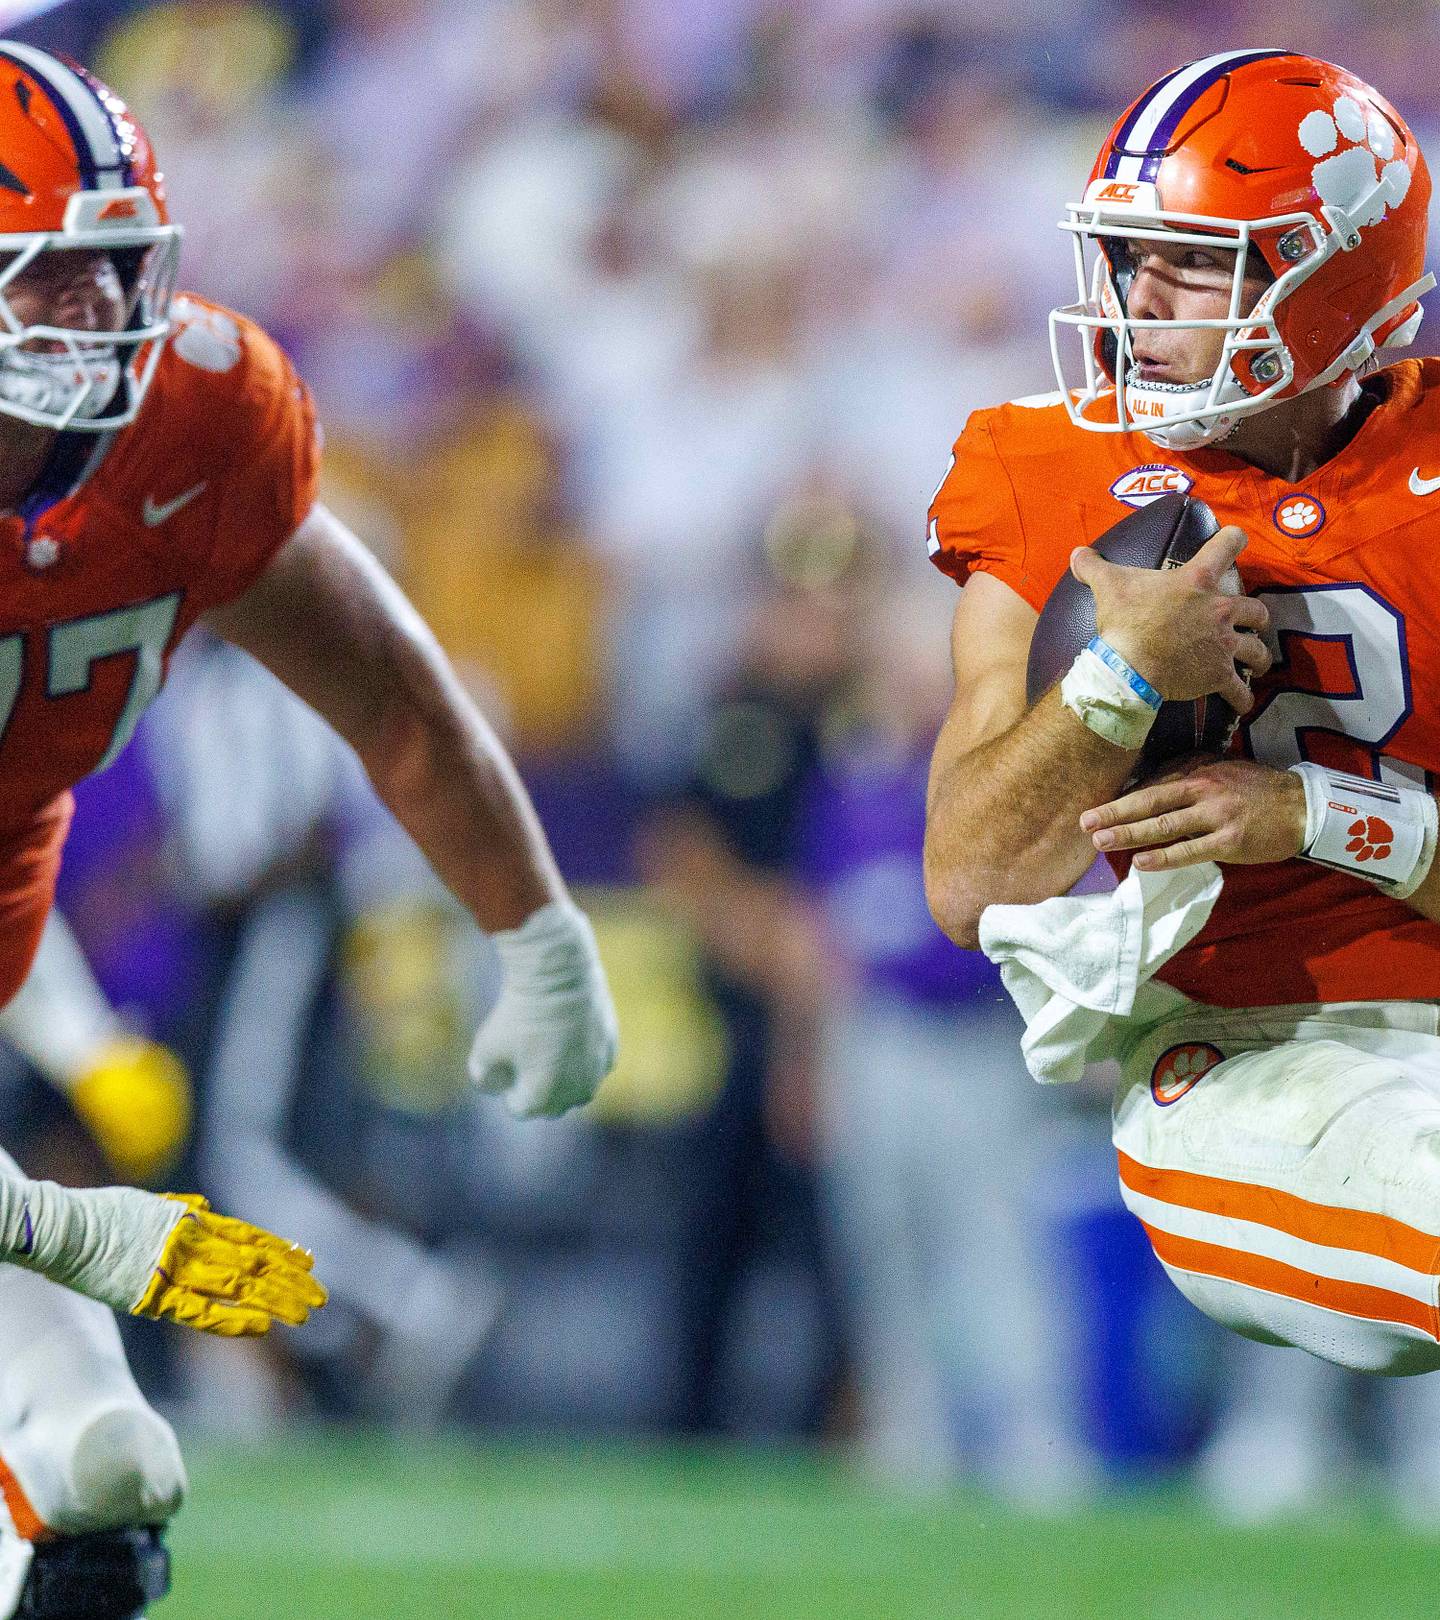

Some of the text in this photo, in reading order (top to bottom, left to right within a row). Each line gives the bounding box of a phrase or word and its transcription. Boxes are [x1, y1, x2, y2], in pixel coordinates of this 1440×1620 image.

[1098, 183, 1140, 200] ACC
[1132, 399, 1164, 417] ALL IN
[1123, 472, 1182, 493] ACC
[0, 586, 187, 772] 7
[1242, 580, 1432, 795] 2
